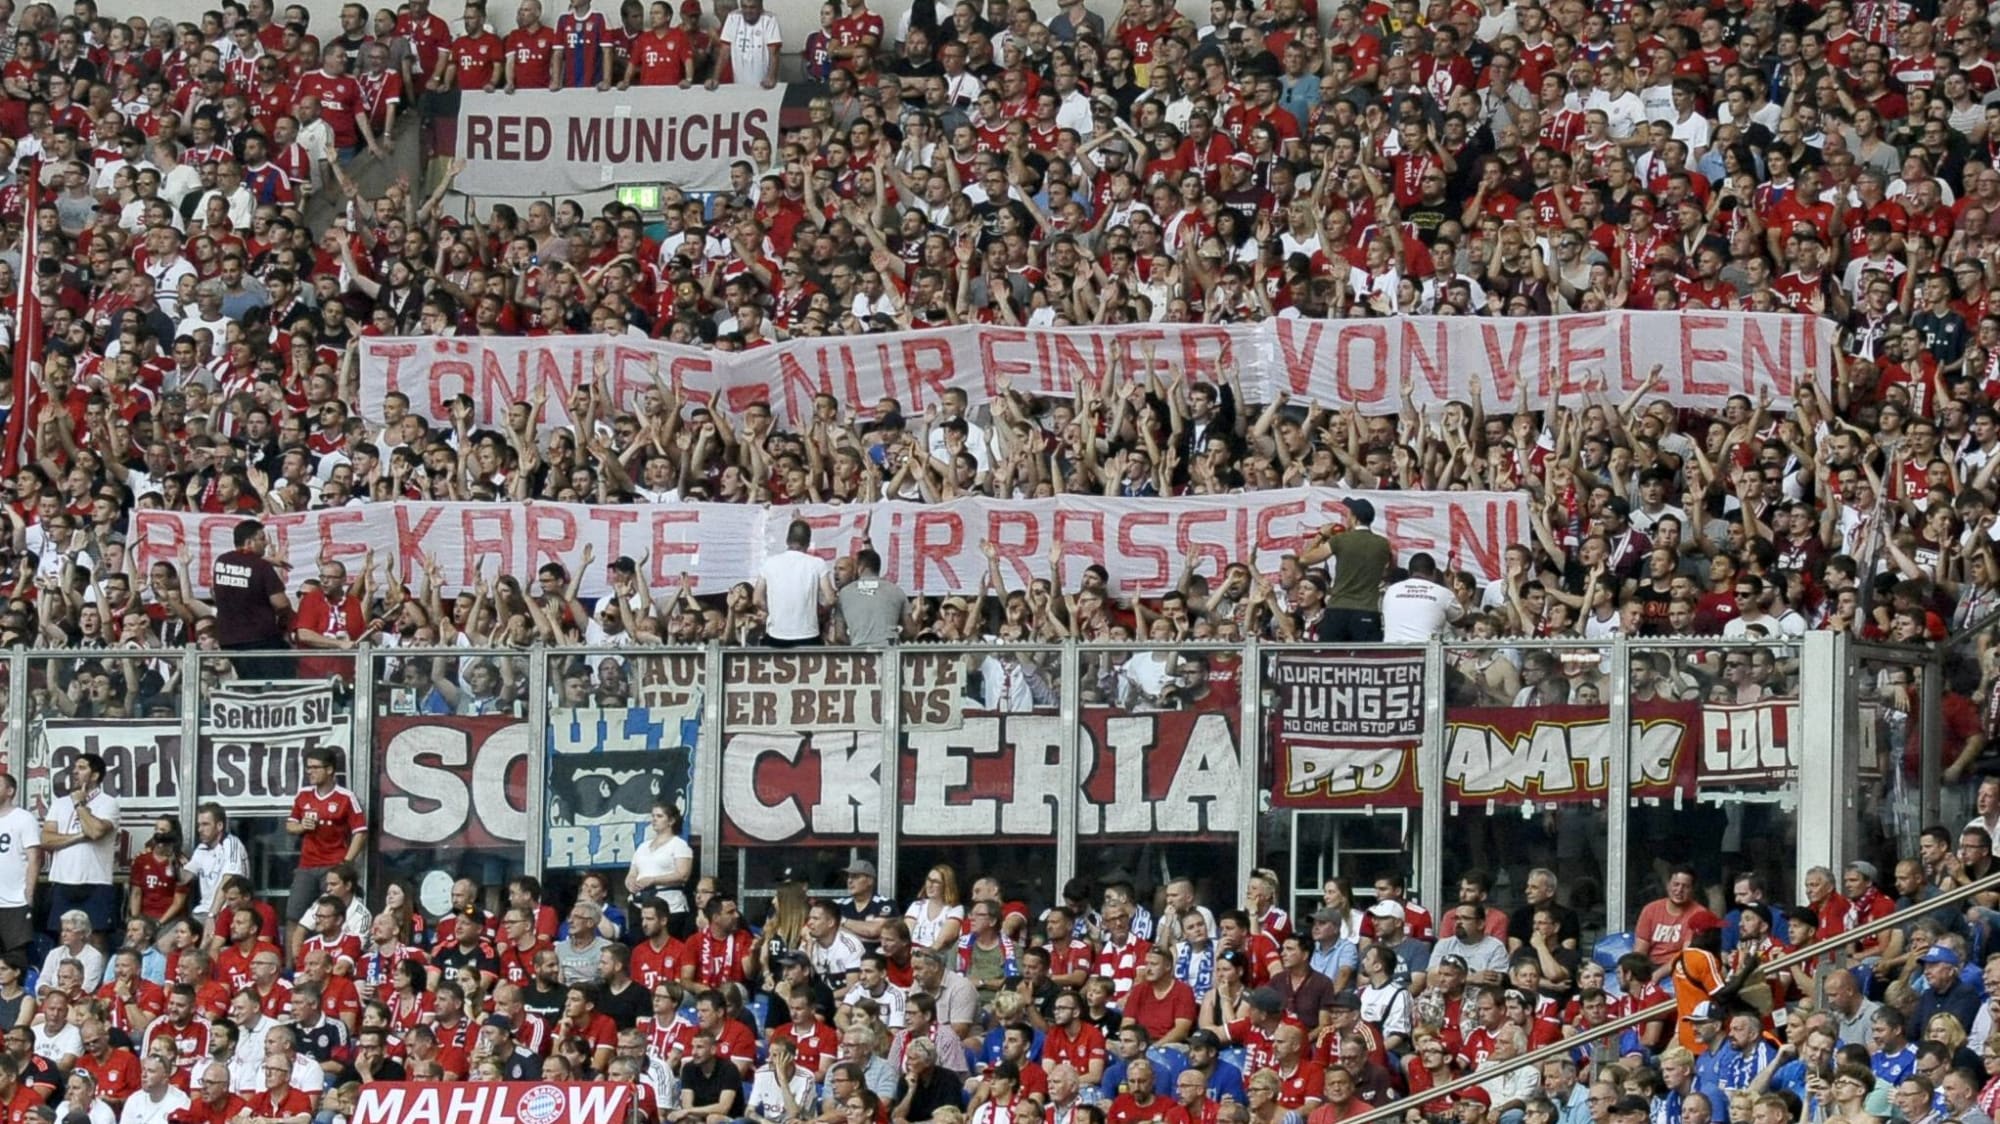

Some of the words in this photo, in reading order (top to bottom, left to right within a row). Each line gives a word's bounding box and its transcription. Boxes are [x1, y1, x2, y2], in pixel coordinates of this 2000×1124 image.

[466, 114, 553, 162] RED
[779, 343, 955, 426] NUR
[1276, 318, 1447, 402] VON
[1481, 314, 1817, 402] VIELEN!
[394, 504, 700, 590] KARTE
[987, 500, 1518, 592] RASSISEN!
[1282, 665, 1421, 685] DURCHHALTEN
[302, 697, 330, 724] SV
[790, 689, 857, 725] BEI
[1283, 685, 1420, 719] JUNGS!
[1283, 720, 1300, 731] NO
[1333, 721, 1357, 733] CAN
[1361, 721, 1395, 733] STOP
[1399, 719, 1416, 732] US
[1287, 746, 1404, 793] RED
